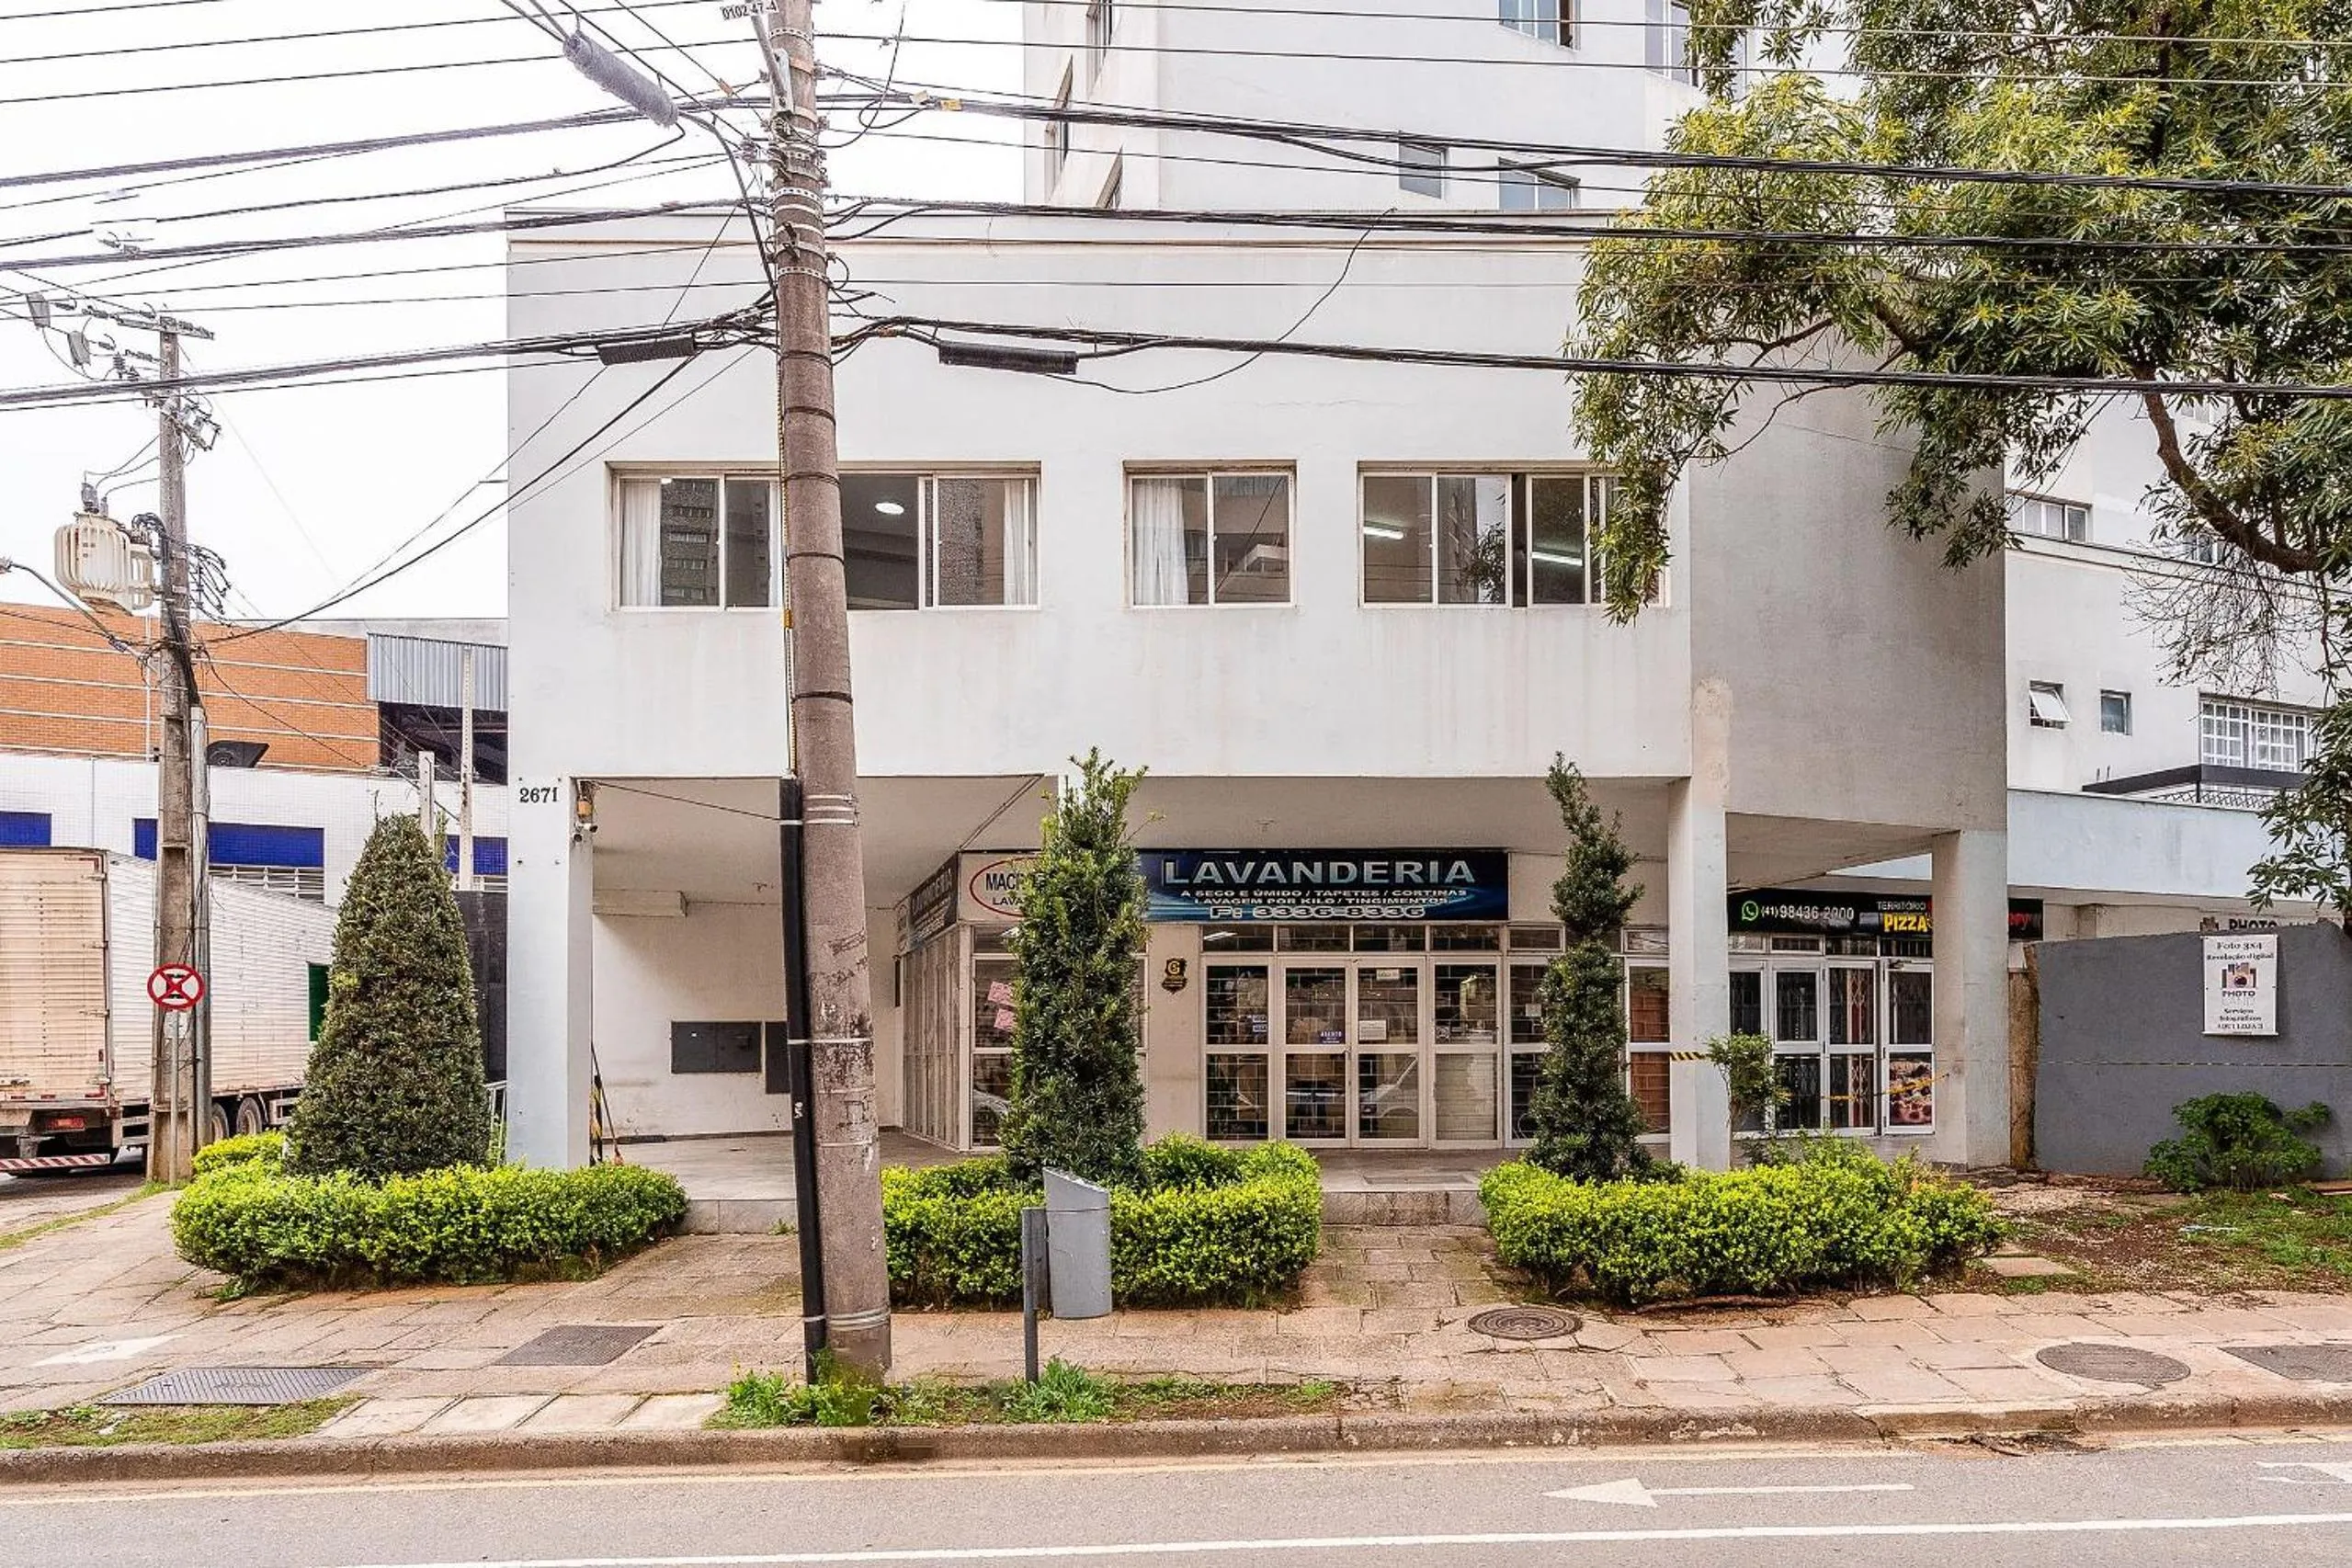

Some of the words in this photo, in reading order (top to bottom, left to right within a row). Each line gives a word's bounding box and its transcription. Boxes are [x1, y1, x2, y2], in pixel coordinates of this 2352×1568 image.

[519, 787, 558, 803] 2671
[1165, 860, 1475, 884] LAVANDERIA
[1883, 912, 1928, 933] PIZZA
